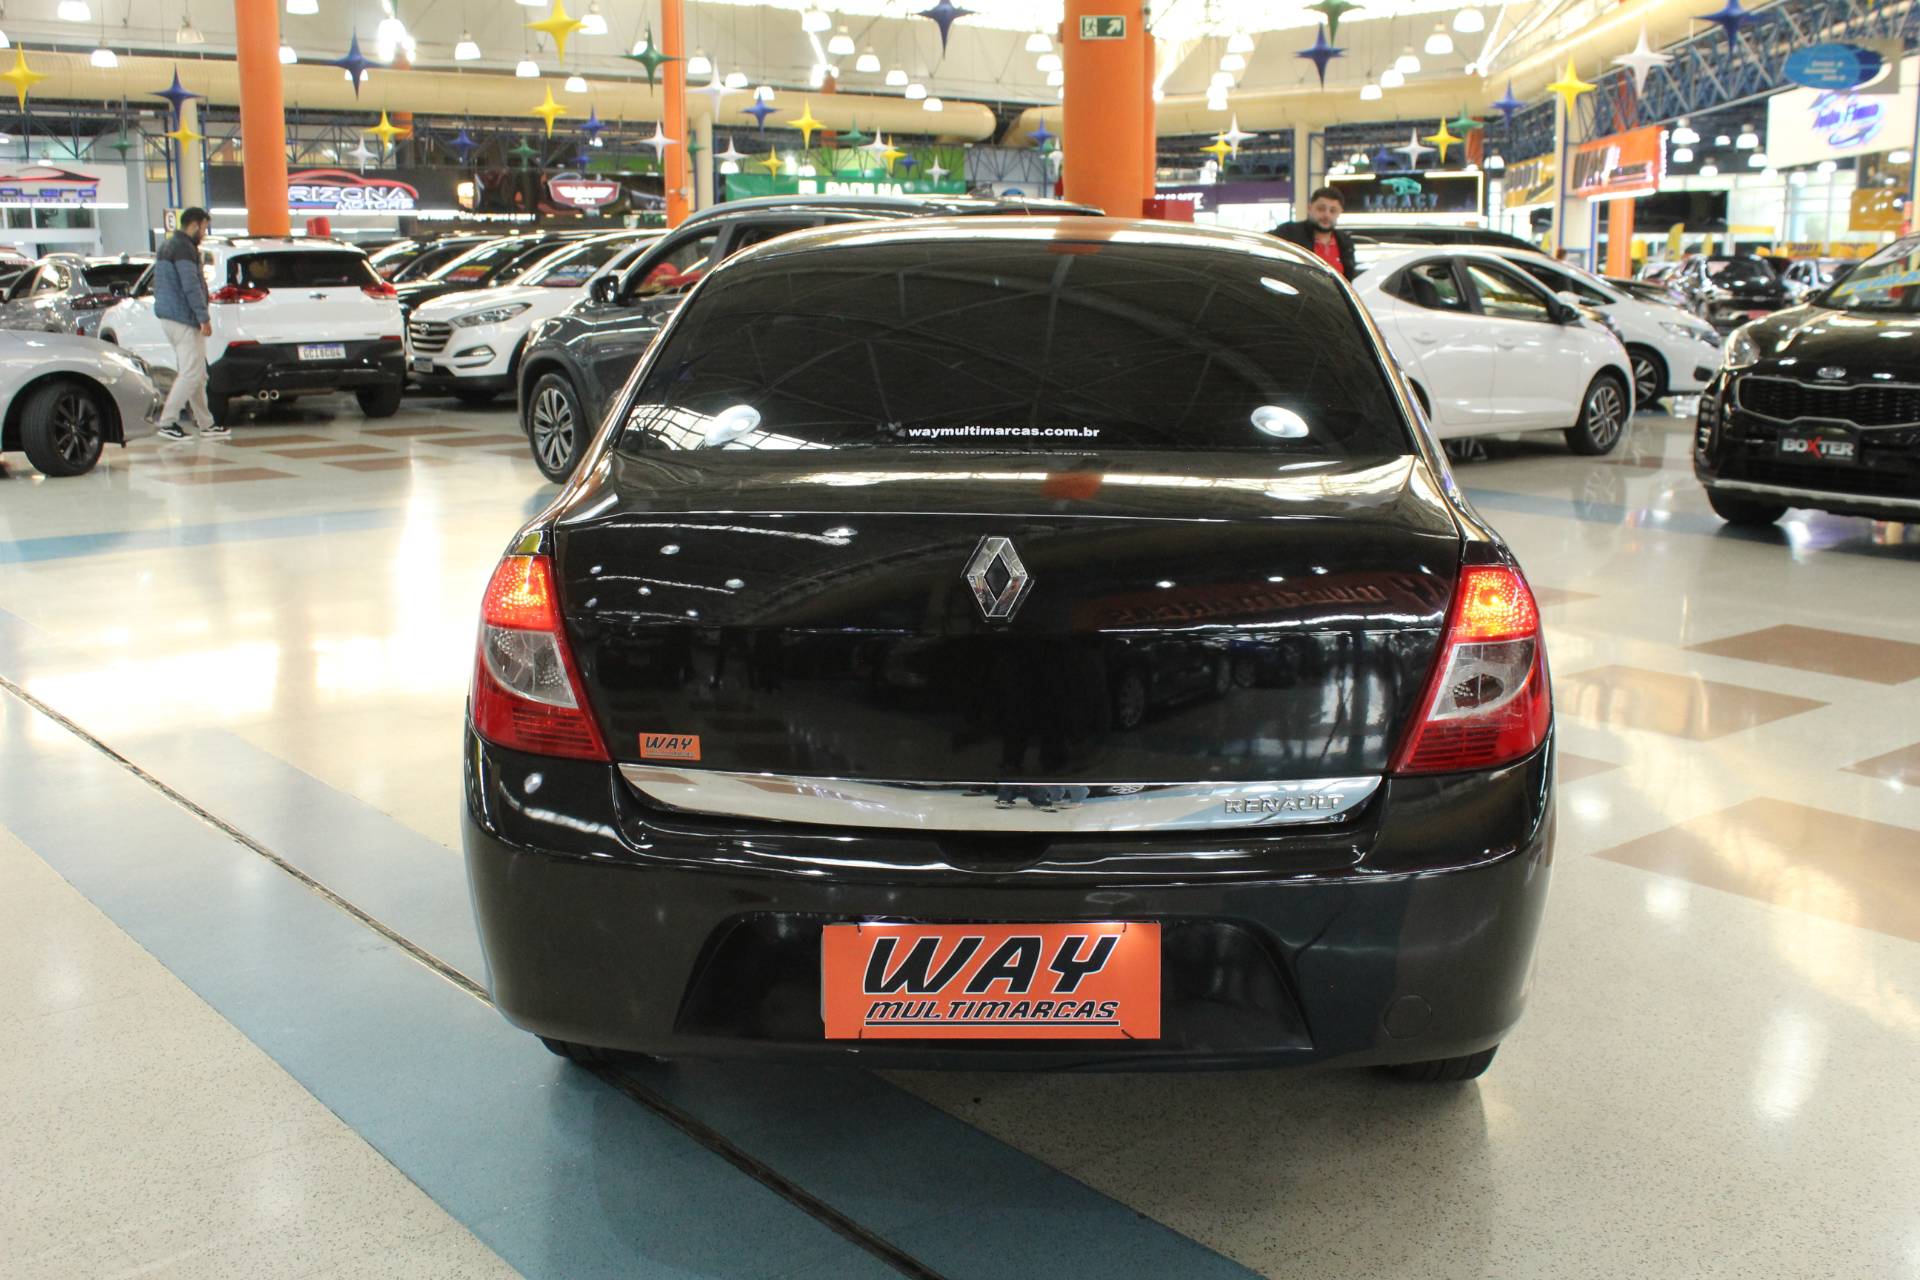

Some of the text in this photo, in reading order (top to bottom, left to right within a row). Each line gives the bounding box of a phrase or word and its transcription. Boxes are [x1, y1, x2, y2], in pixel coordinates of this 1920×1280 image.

[908, 425, 1100, 438] waymultimarcas.com.br
[1781, 436, 1855, 458] BOXTER
[645, 736, 693, 750] WAY
[1225, 794, 1345, 814] RENAULT
[863, 935, 1120, 995] WAY
[864, 1000, 1120, 1020] MULTIMARCAS
